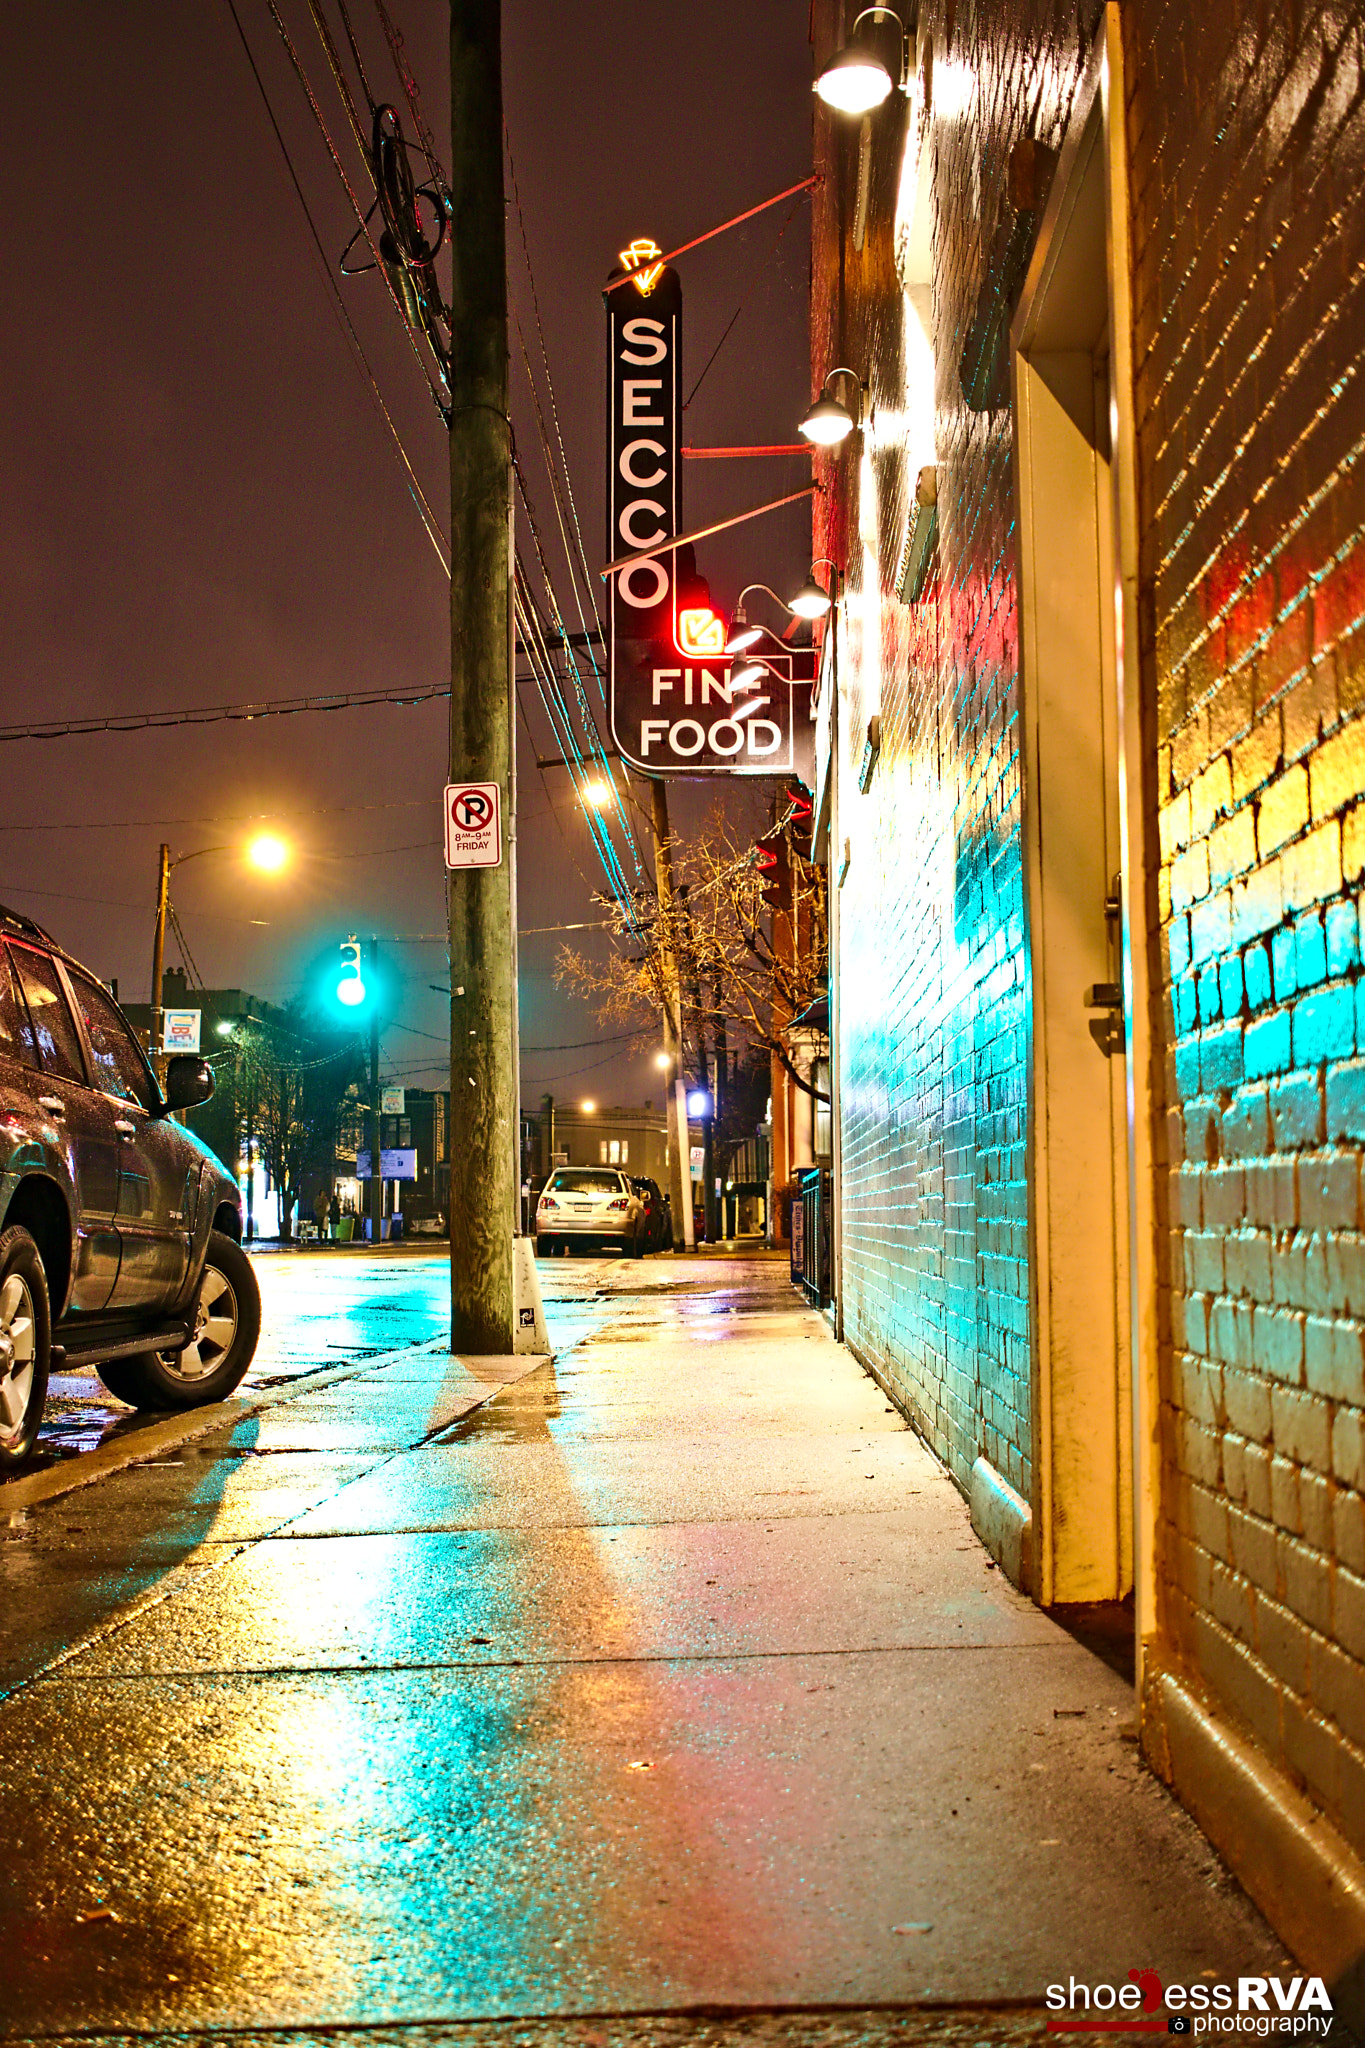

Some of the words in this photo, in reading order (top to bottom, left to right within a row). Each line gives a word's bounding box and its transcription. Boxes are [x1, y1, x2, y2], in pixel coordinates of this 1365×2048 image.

[618, 318, 669, 609] SECCO
[641, 719, 782, 756] FOOD
[457, 841, 489, 850] FRIDAY
